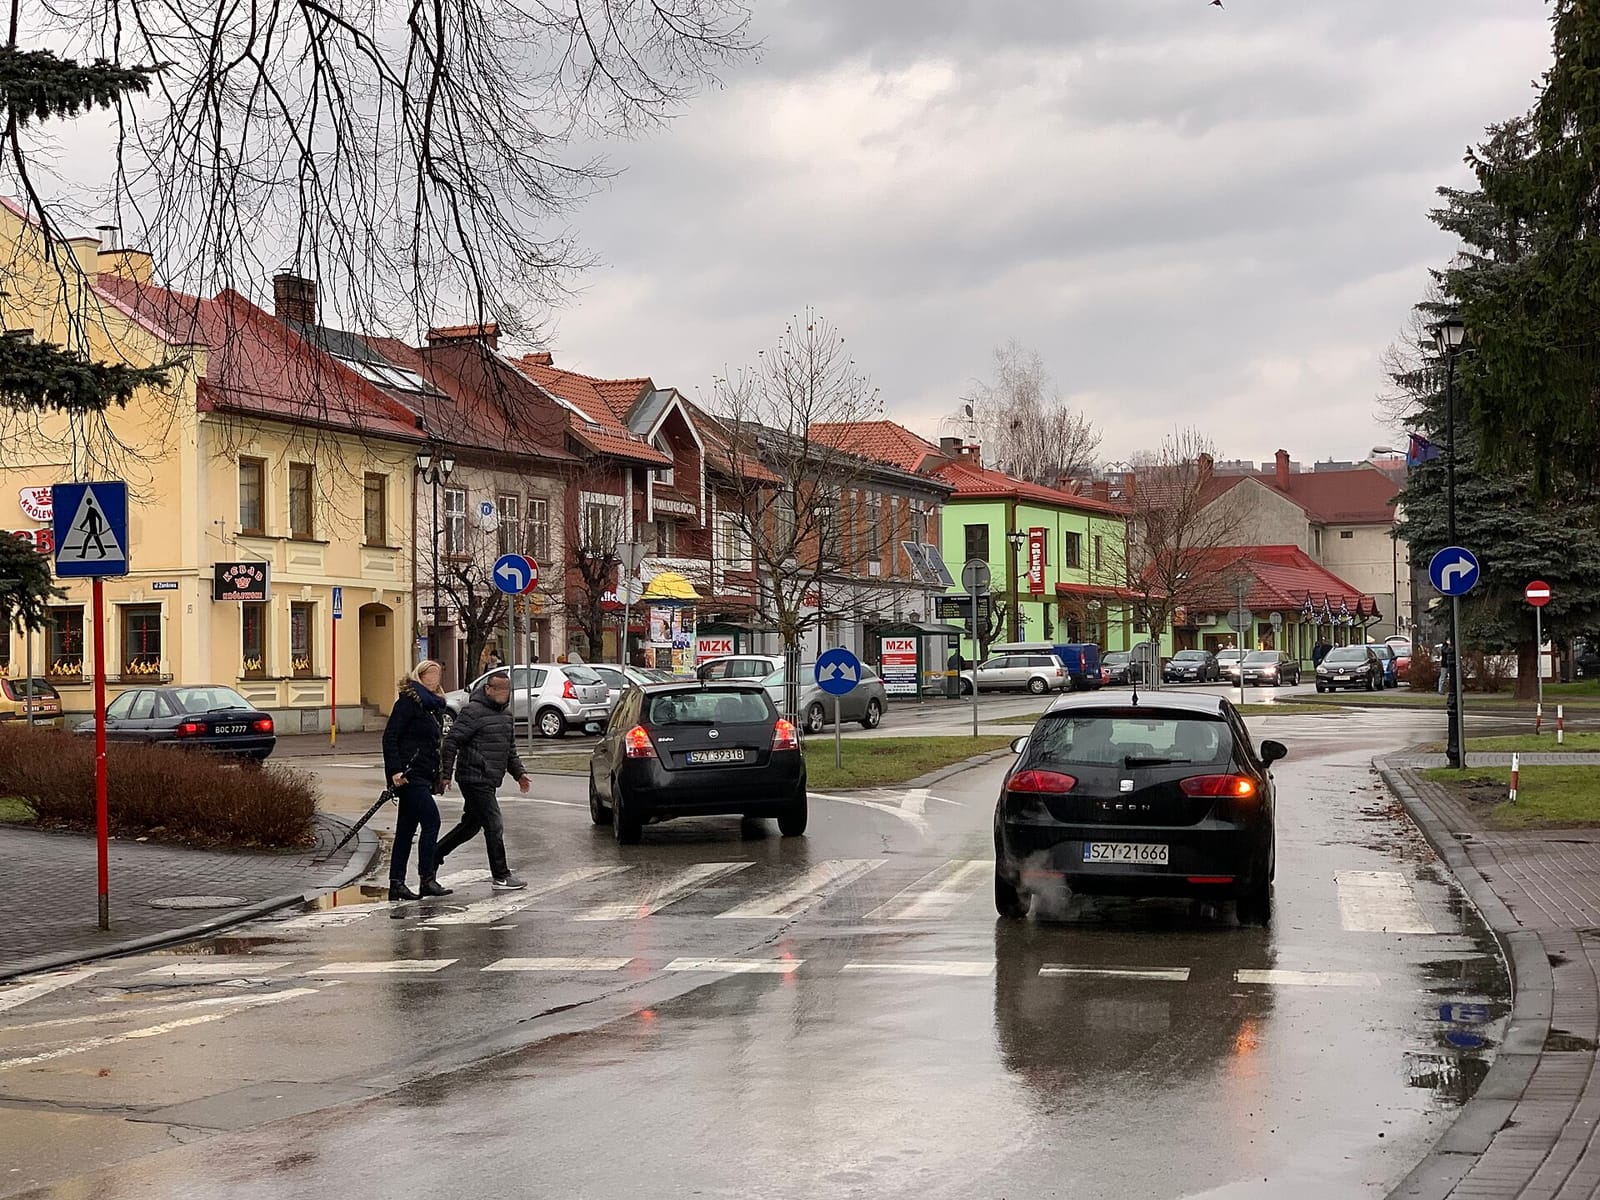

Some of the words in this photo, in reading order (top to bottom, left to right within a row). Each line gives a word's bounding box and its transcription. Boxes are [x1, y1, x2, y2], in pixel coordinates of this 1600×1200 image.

[699, 640, 732, 651] MZK
[886, 640, 914, 650] MZK
[215, 726, 230, 734] BOC
[231, 725, 247, 733] 7777
[692, 752, 711, 761] SZY
[713, 749, 743, 760] 39318
[1091, 844, 1119, 859] SZY
[1123, 845, 1168, 861] 21666
